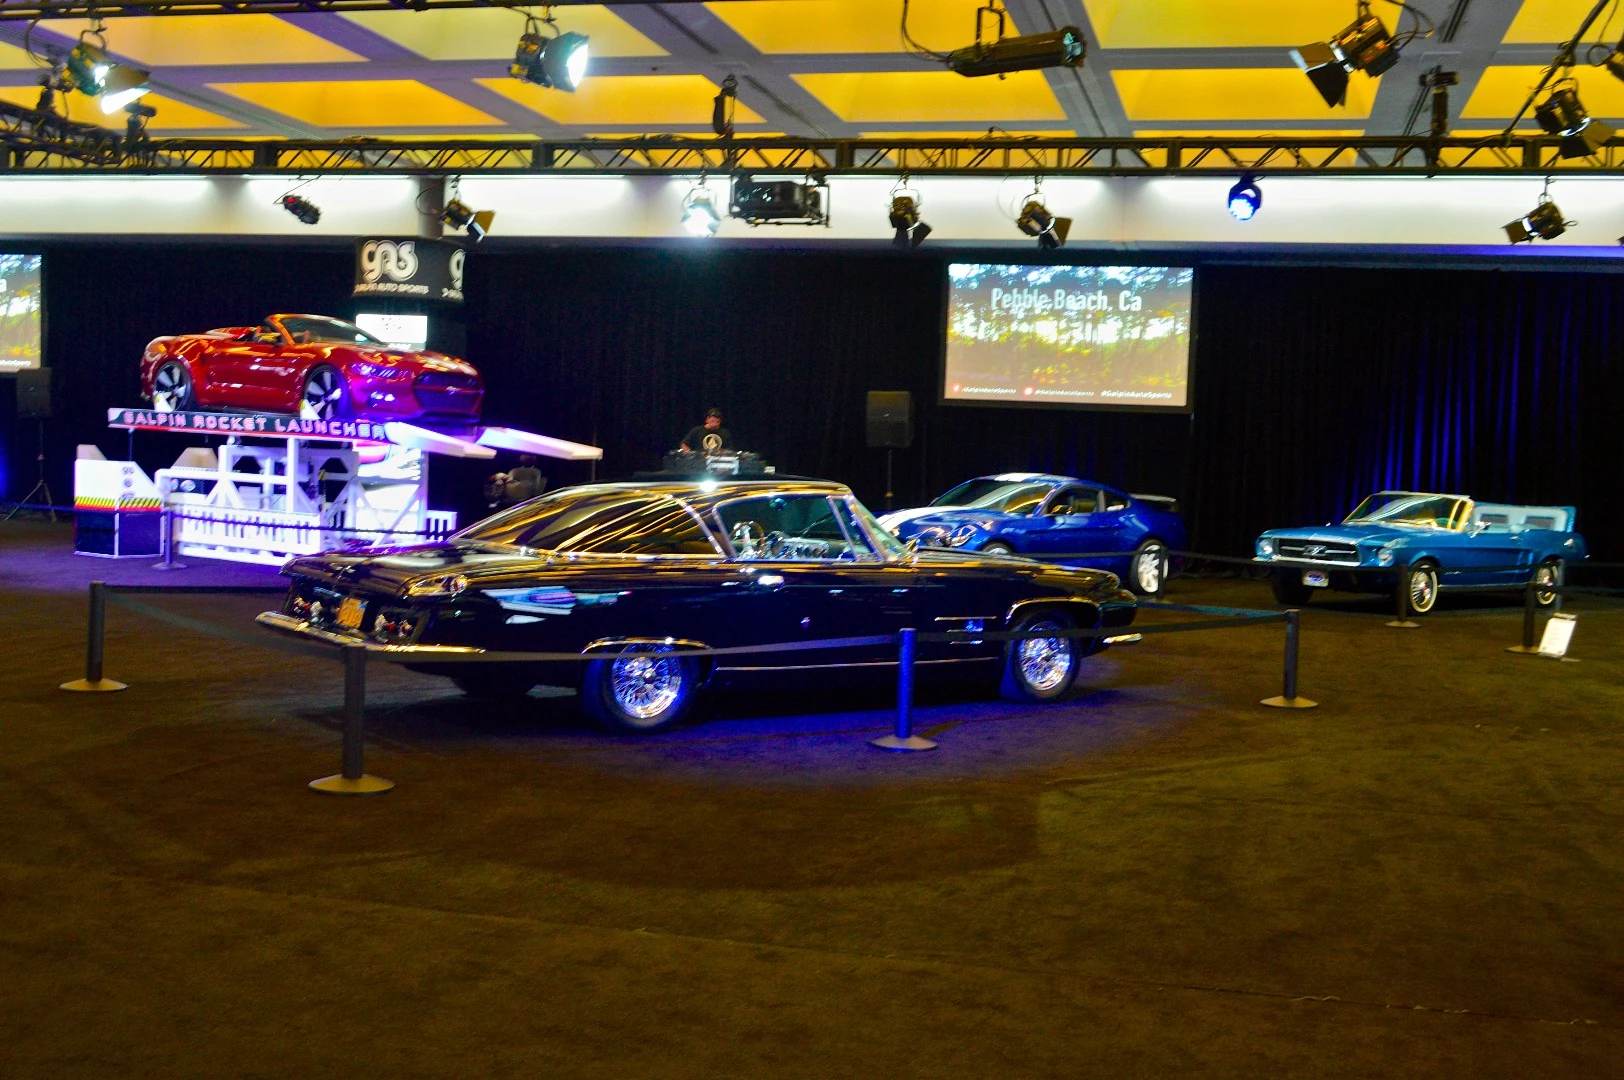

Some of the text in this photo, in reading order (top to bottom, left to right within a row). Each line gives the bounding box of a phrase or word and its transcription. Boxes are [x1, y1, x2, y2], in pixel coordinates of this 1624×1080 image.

[990, 287, 1143, 312] Pebble Beach, Ca
[123, 411, 385, 440] GALPIN ROCKET LAUNCHER
